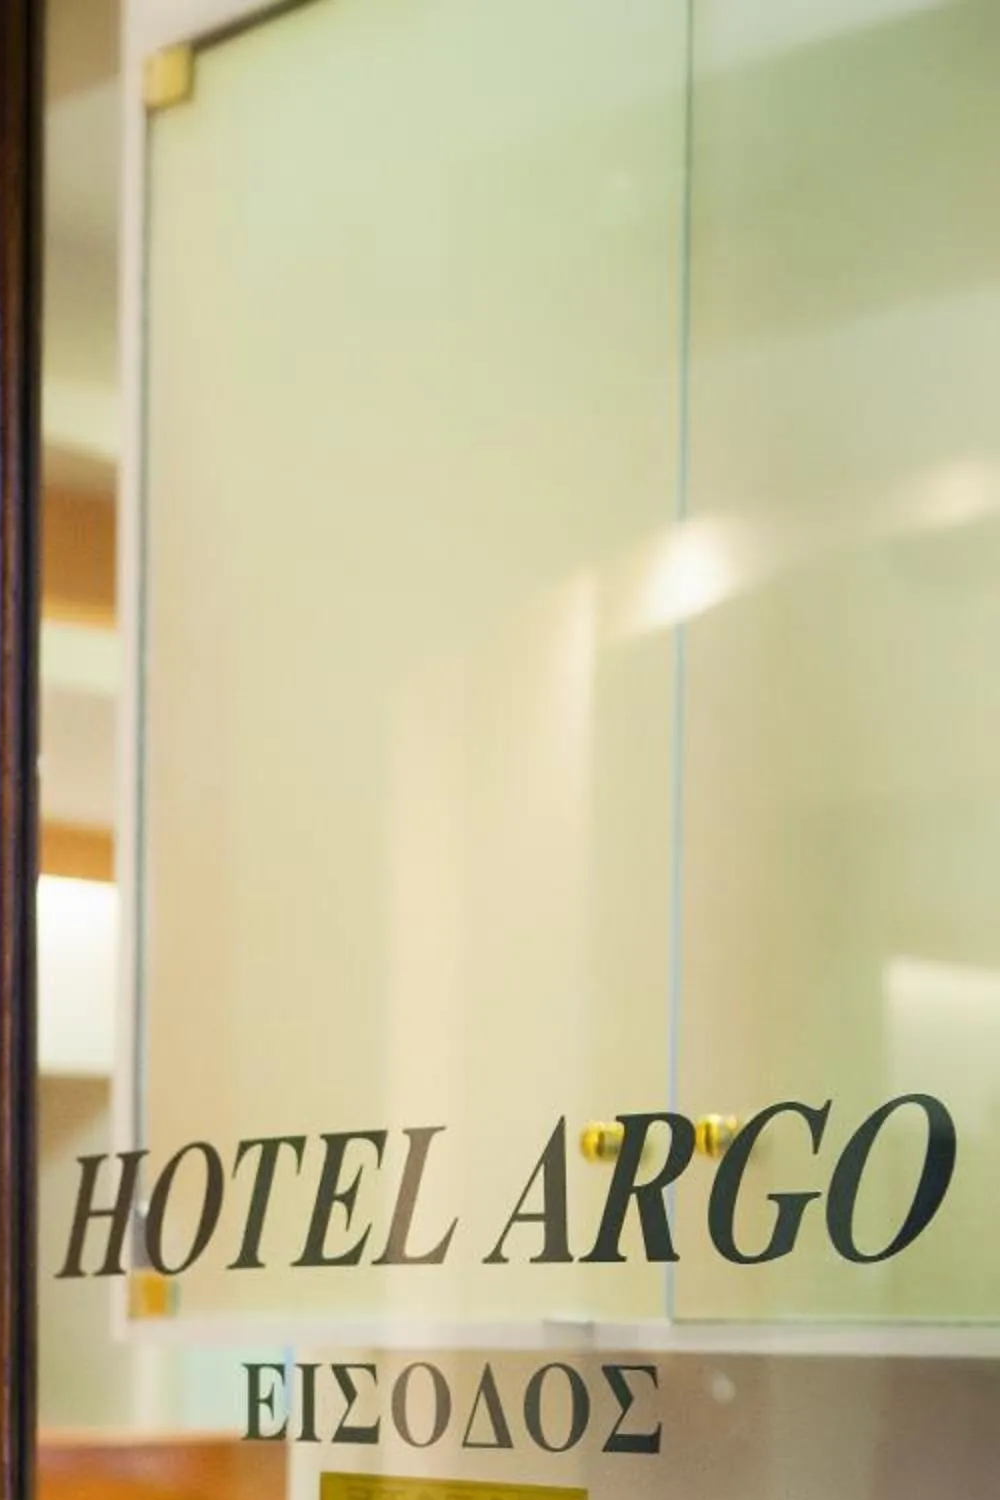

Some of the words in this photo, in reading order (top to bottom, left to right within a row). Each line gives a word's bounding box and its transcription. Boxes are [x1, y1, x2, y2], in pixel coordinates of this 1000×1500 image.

[55, 1127, 458, 1279] HOTEL
[482, 1093, 957, 1264] ARGO
[242, 1362, 661, 1453] ΕΙΣΟΔΟΣ
